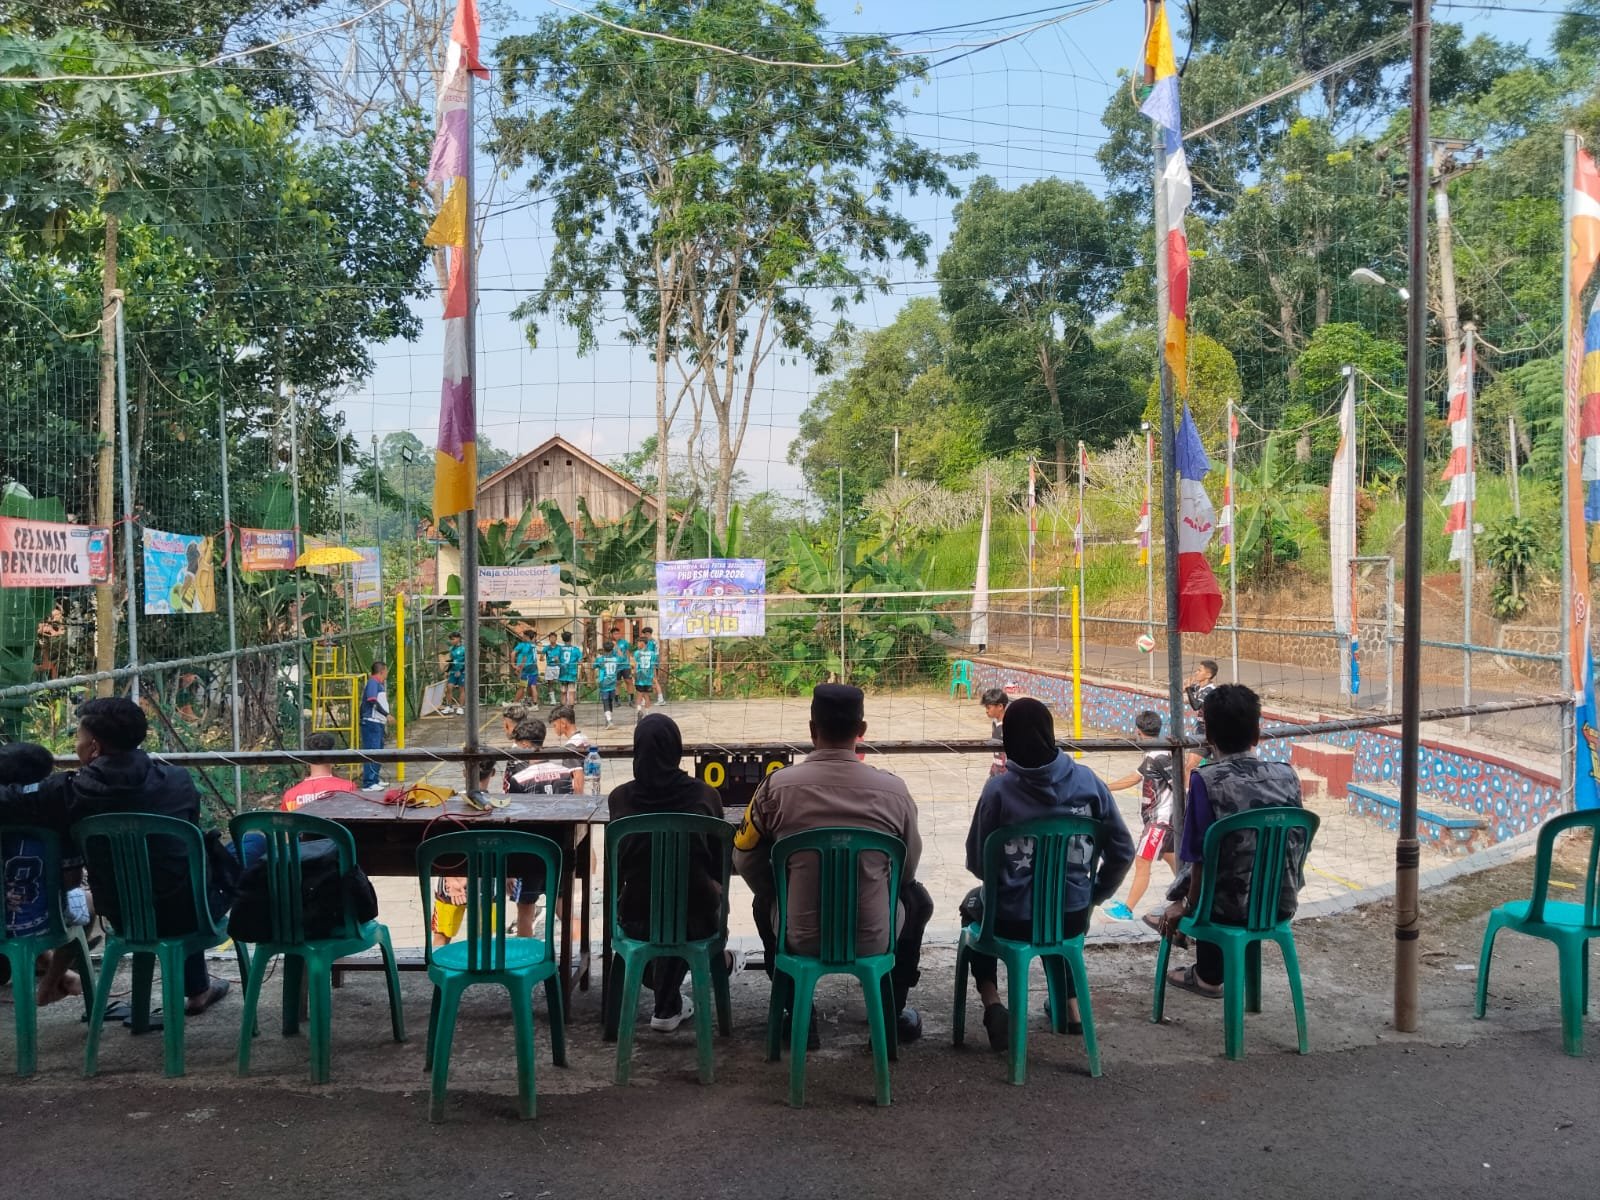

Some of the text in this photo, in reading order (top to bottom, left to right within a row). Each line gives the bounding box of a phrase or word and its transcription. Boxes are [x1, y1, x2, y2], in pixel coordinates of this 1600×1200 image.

[14, 526, 67, 551] SELAMAT
[1, 550, 79, 574] BERTANDING
[479, 567, 549, 578] Naja collection
[710, 570, 724, 578] CUP
[686, 615, 739, 634] PHB
[704, 761, 725, 788] 0
